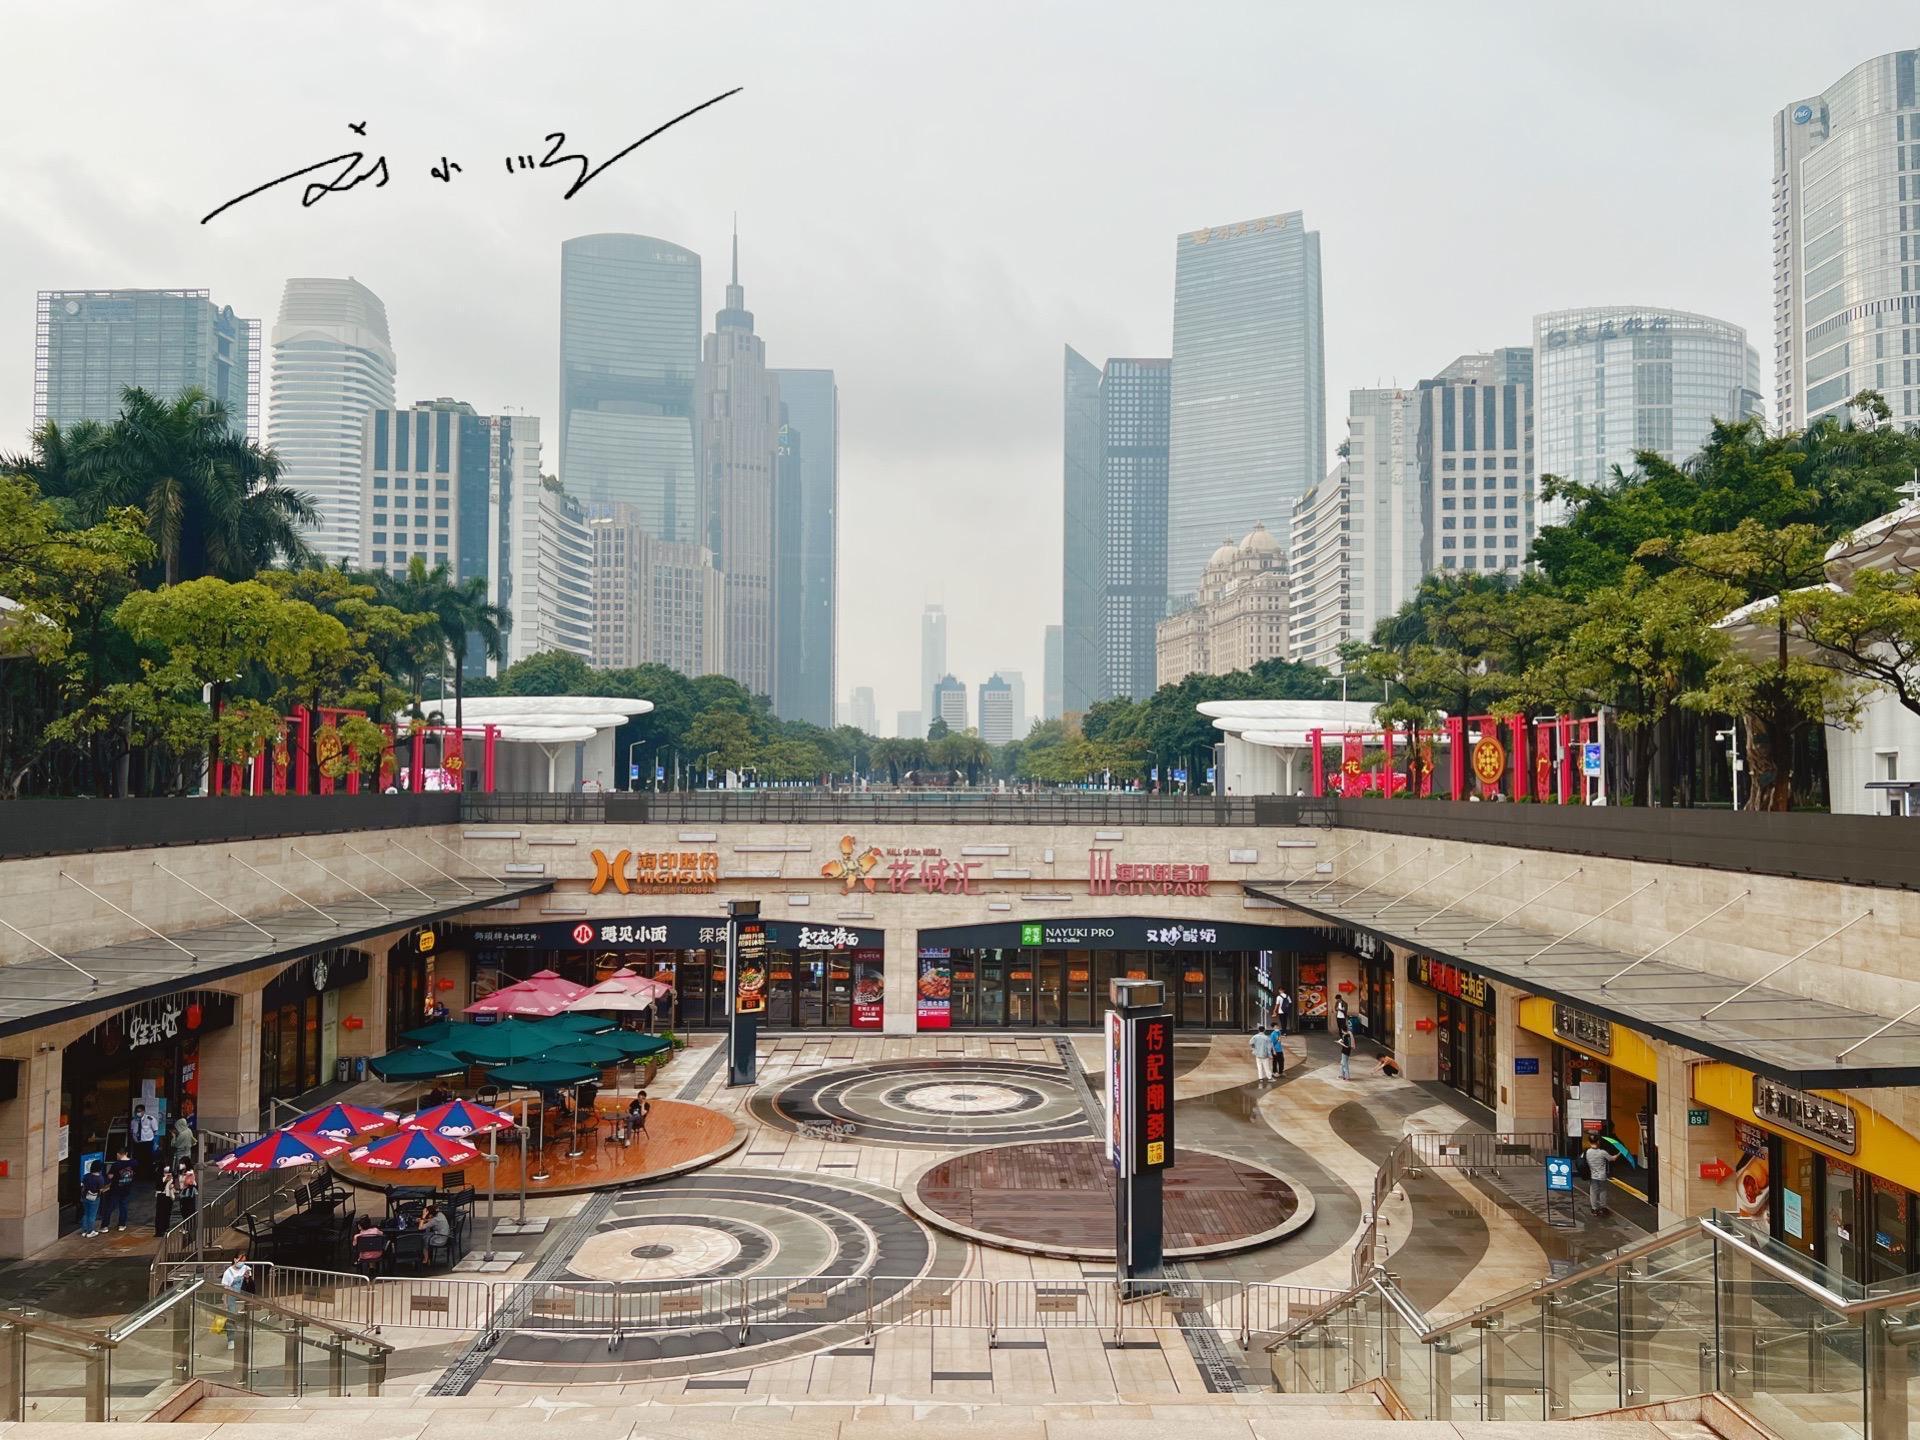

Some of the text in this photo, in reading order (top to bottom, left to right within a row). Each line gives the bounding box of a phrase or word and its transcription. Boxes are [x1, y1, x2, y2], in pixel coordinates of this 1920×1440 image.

[446, 757, 463, 770] 场
[1346, 759, 1361, 773] 花
[637, 852, 718, 870] 海印股份
[636, 870, 718, 884] HIGHSUN
[887, 858, 984, 896] 花城汇
[601, 925, 667, 943] 遇见小面
[798, 926, 859, 948] 和府捞面
[1045, 928, 1115, 938] NAYUKI PRO
[1691, 1116, 1702, 1124] 89
